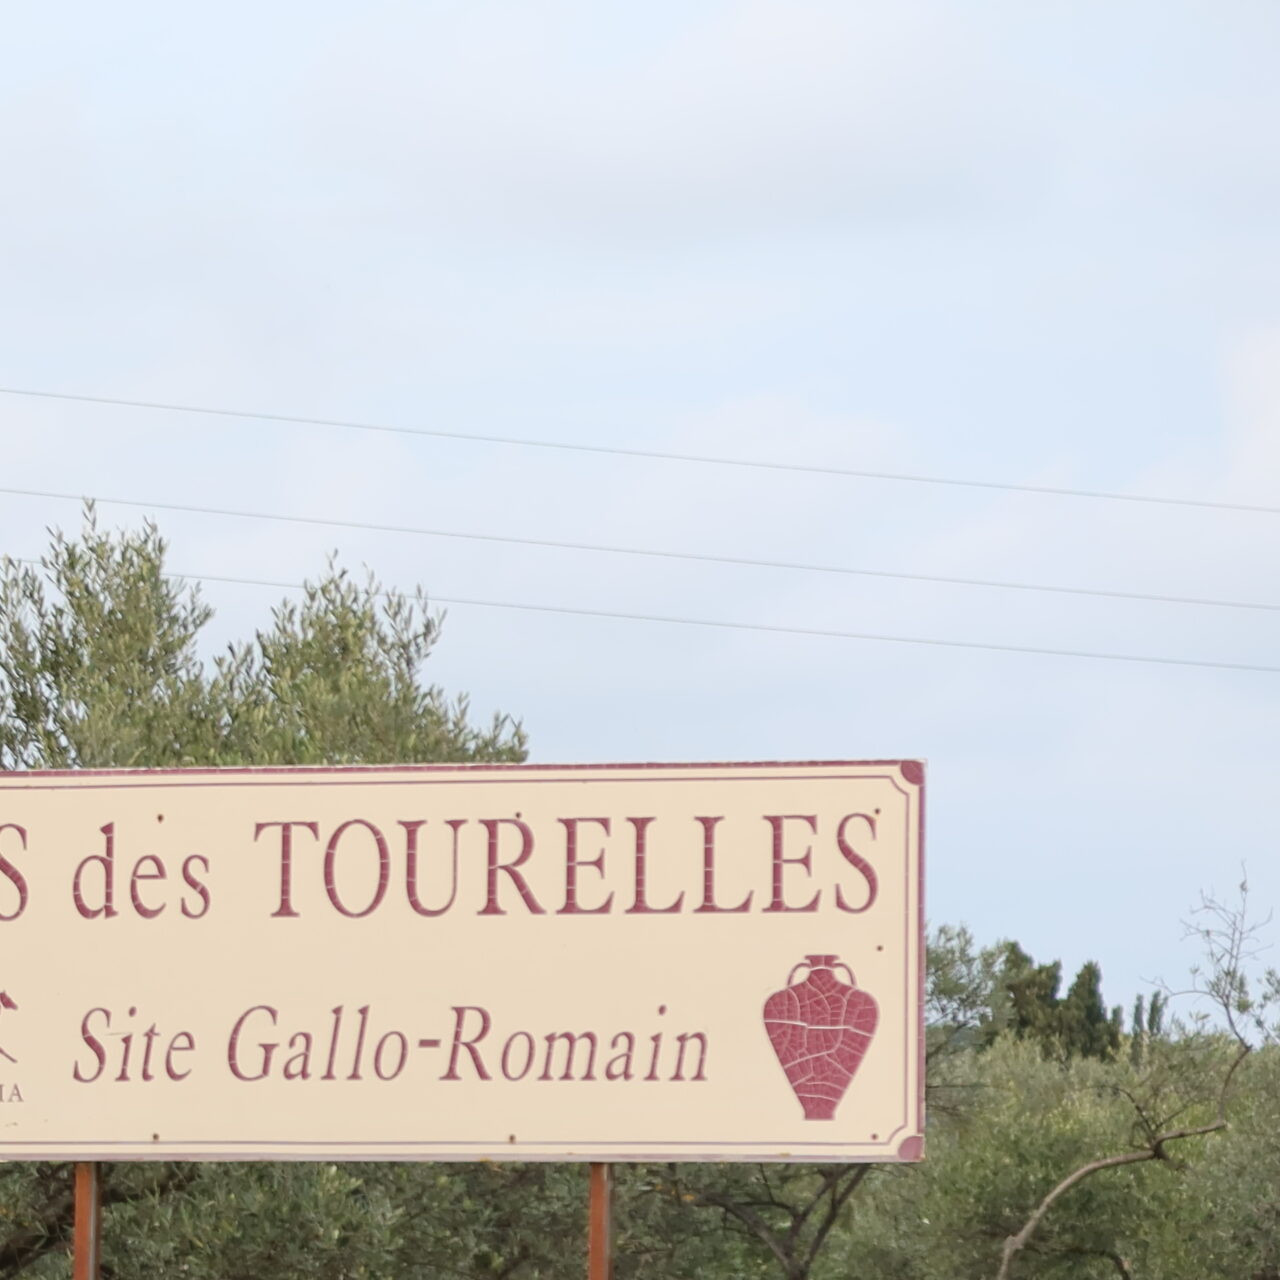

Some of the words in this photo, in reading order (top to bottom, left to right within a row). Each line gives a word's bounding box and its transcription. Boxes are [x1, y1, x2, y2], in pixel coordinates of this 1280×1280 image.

[71, 820, 212, 921] des
[253, 811, 880, 919] TOURELLES
[72, 1006, 196, 1084] Site
[226, 1003, 709, 1084] Gallo-Romain
